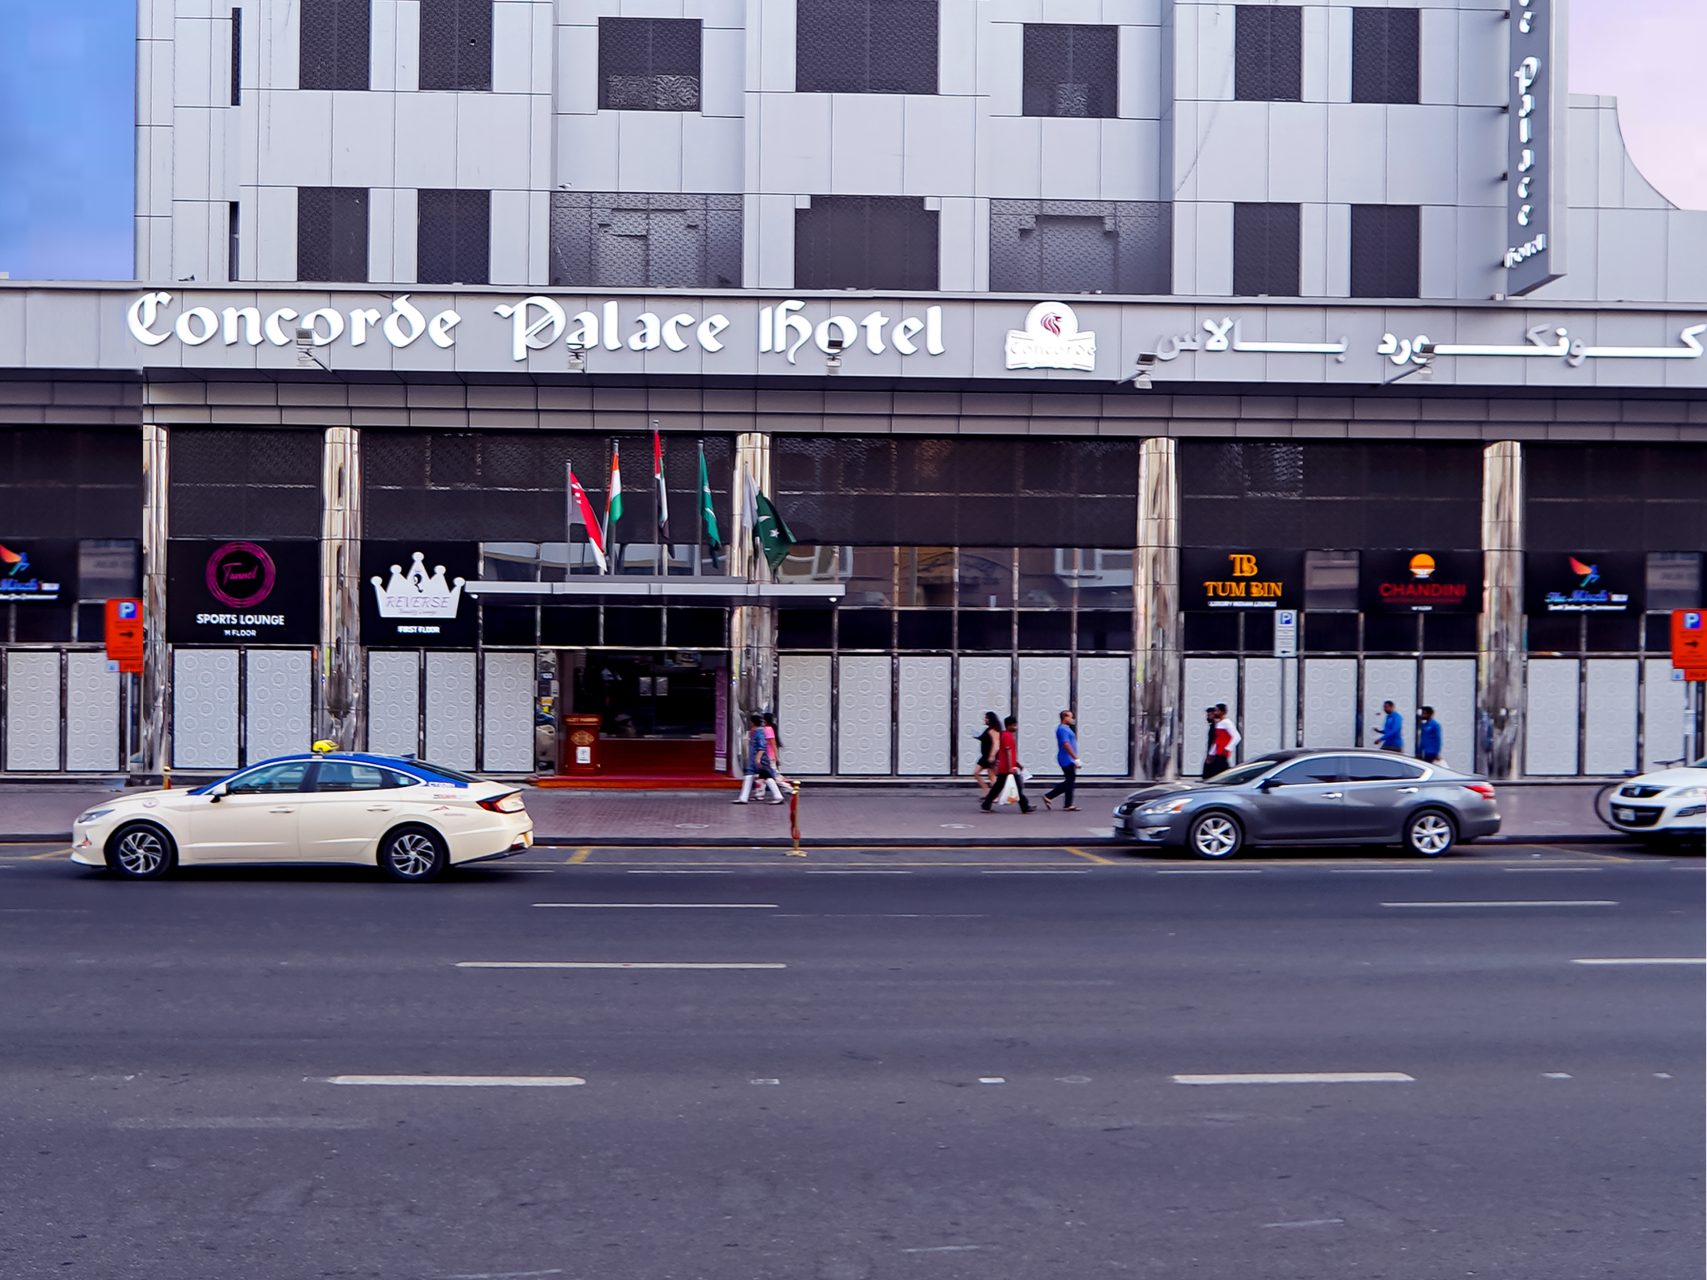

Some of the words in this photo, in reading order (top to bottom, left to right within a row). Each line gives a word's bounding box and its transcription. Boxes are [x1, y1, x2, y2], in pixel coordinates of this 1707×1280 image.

[1514, 56, 1541, 226] Palace
[127, 291, 462, 349] Concorde
[493, 295, 731, 362] Palace
[759, 299, 946, 365] Hotel
[1203, 581, 1246, 597] TUM
[1249, 581, 1283, 597] BIN
[1378, 583, 1467, 597] CHANDINI
[385, 595, 451, 609] REVERSE
[196, 613, 238, 625] SPORTS
[239, 614, 285, 626] LOUNGE
[231, 629, 257, 637] FLOOR
